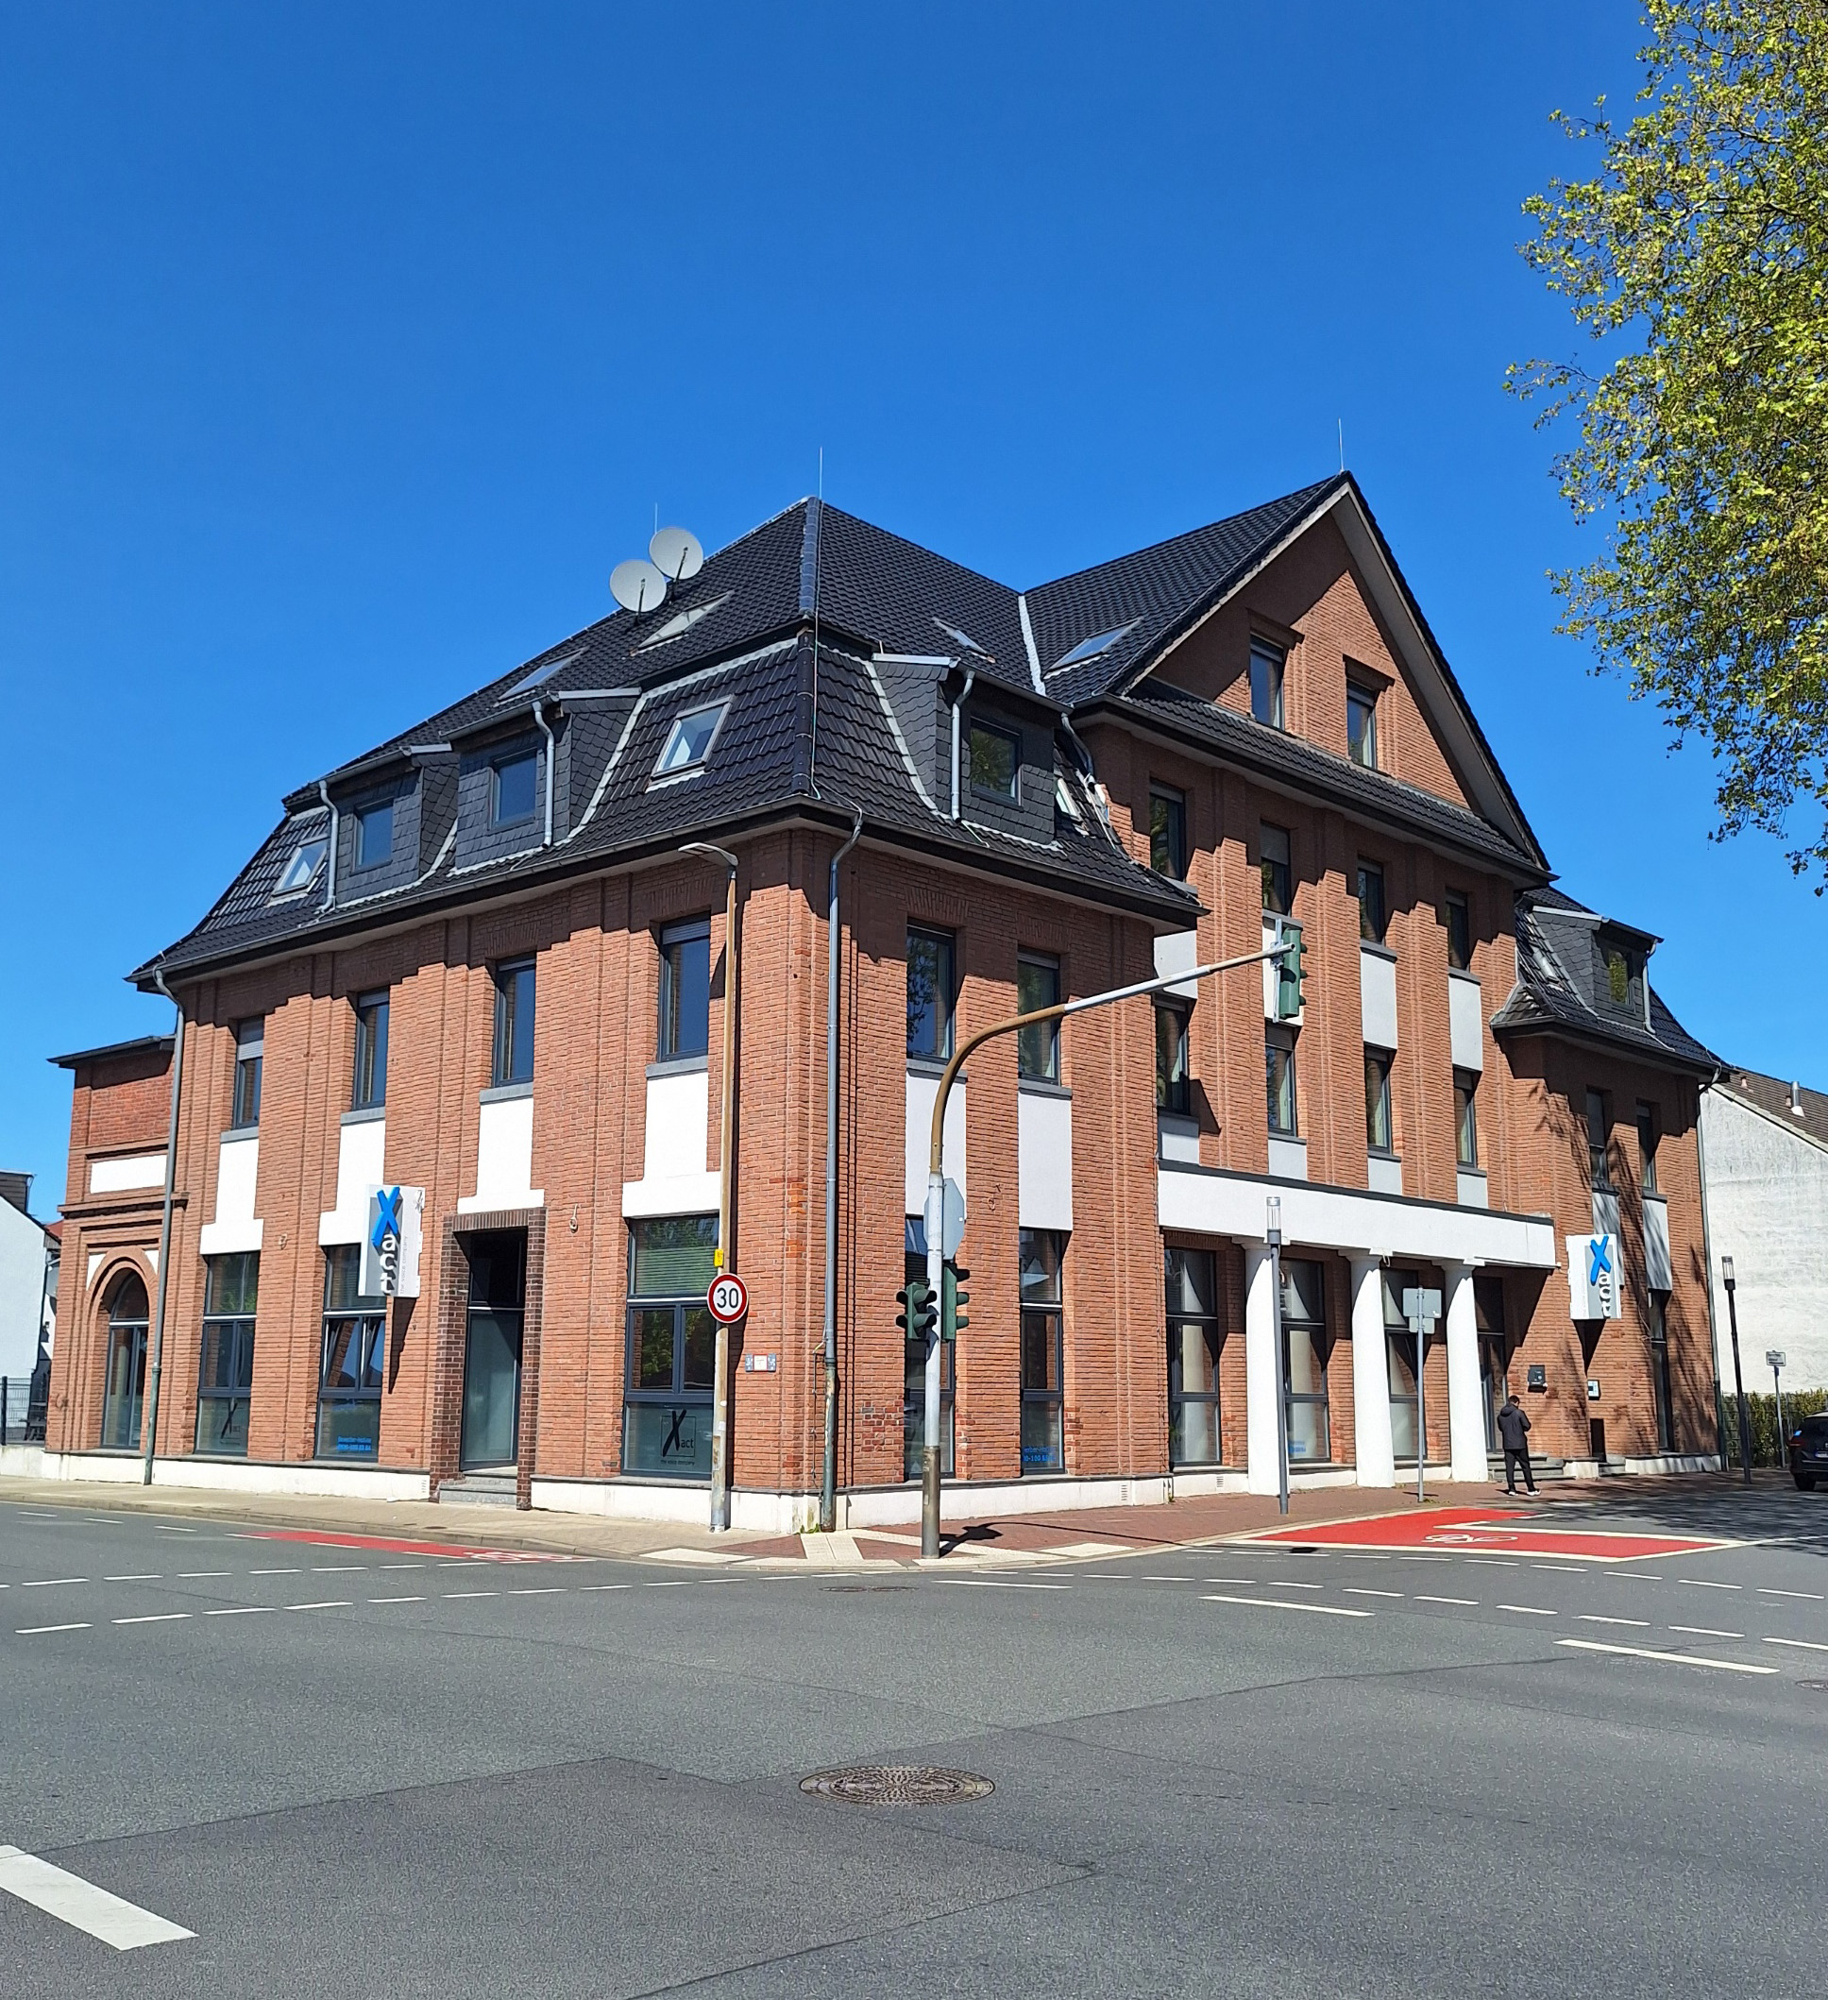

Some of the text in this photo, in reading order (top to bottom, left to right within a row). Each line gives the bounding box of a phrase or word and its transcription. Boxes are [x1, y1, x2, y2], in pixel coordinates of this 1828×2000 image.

[371, 1187, 400, 1294] Xact
[717, 1288, 739, 1309] 30
[1590, 1235, 1611, 1317] Xact
[663, 1409, 694, 1457] Xact
